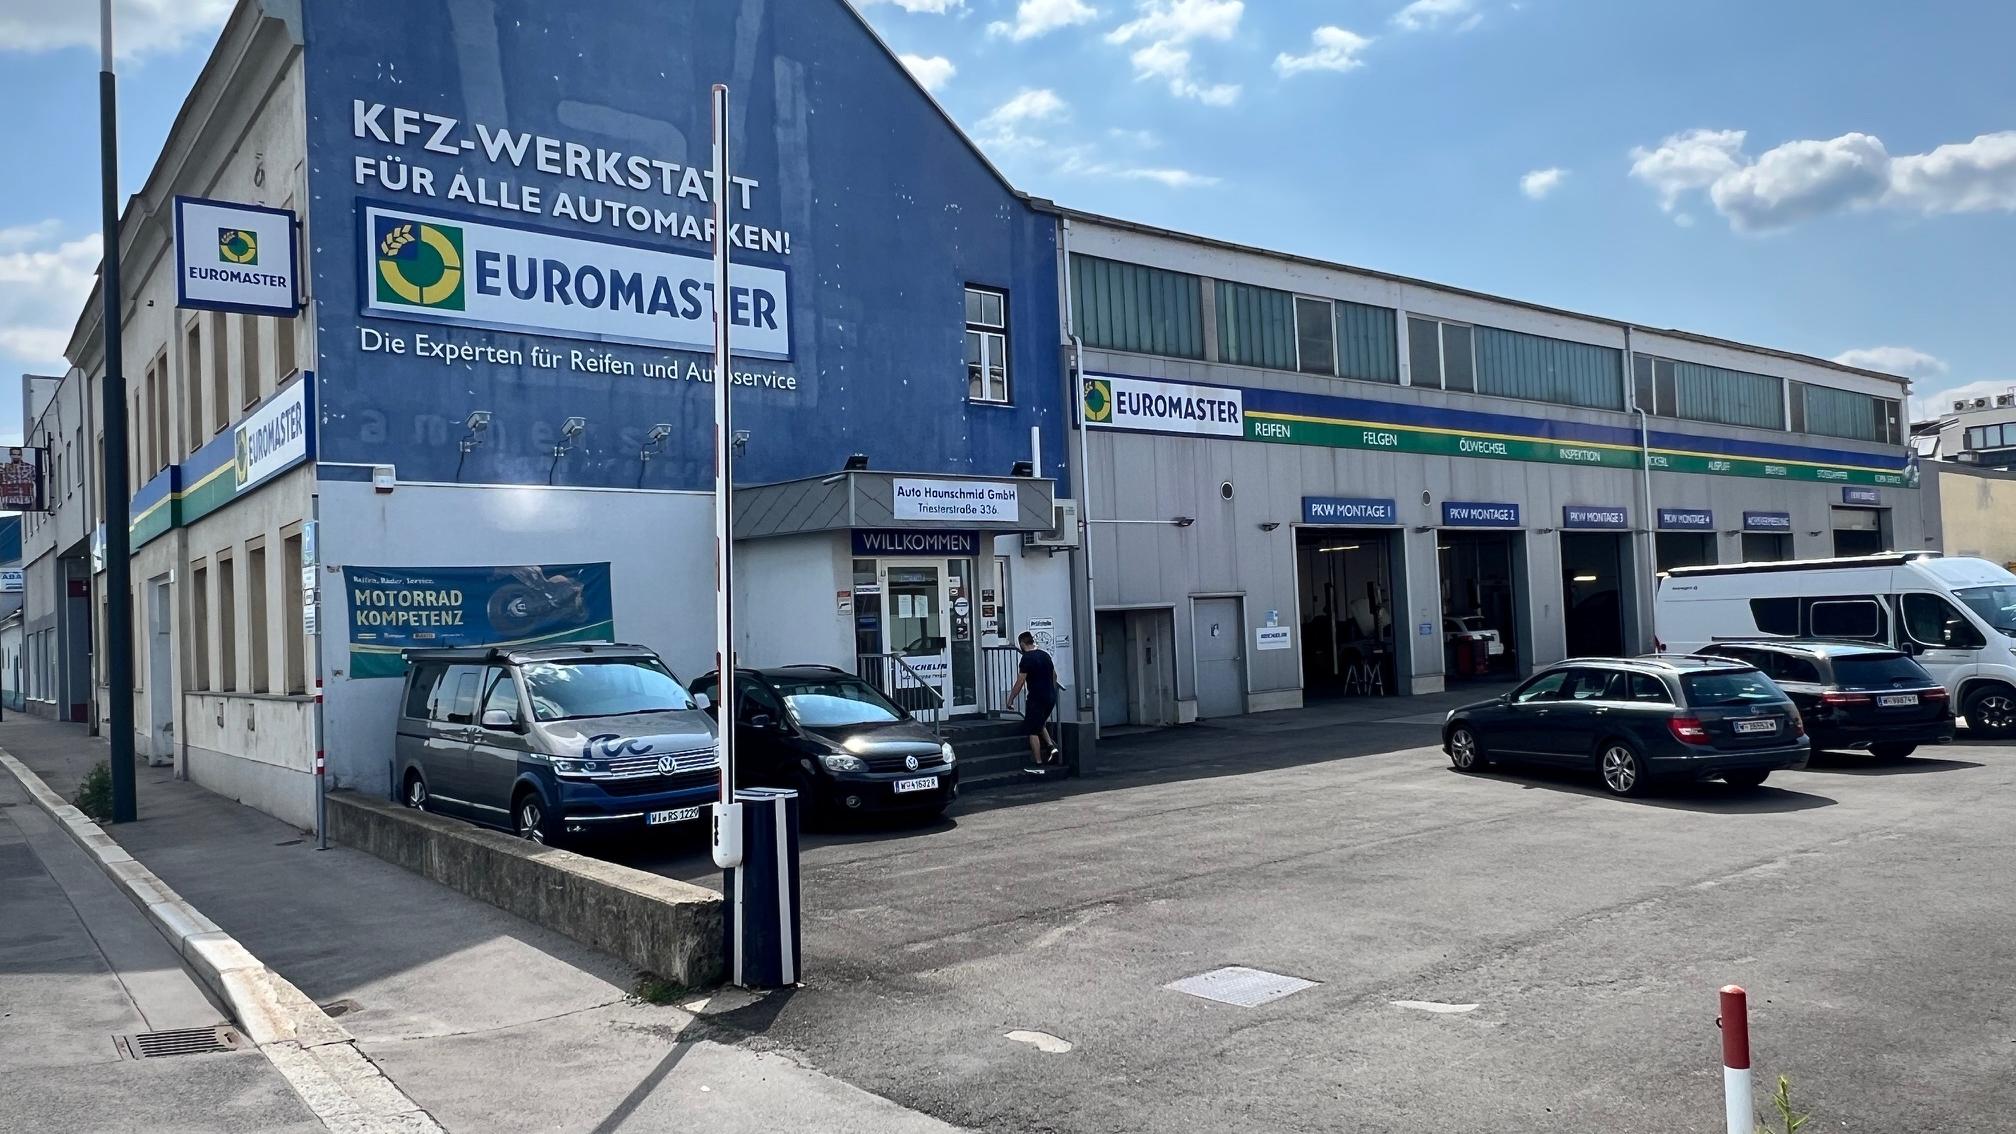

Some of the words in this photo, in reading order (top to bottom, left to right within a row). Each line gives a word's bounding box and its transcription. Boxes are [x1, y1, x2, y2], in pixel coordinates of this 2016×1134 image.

[355, 155, 436, 196] FÜR
[448, 173, 541, 214] ALLE
[189, 266, 287, 288] EUROMASTER
[360, 328, 406, 354] Die
[415, 333, 522, 366] Experten
[530, 346, 562, 369] für
[571, 349, 635, 376] Reifen
[643, 361, 678, 379] und
[1117, 391, 1239, 424] EUROMASTER
[249, 400, 302, 467] EUROMASTER
[1255, 422, 1290, 438] REIFEN
[1363, 431, 1398, 446] FELGEN
[1459, 438, 1508, 455] ÖLWECHSEL
[1559, 448, 1601, 462] INSPEKTION
[897, 486, 921, 497] Auto
[924, 487, 984, 499] Haunschmid
[987, 489, 1016, 500] GmbH
[918, 503, 977, 514] Triesterstraße
[1312, 504, 1335, 516] PKW
[1337, 505, 1385, 517] MONTAGE
[1449, 508, 1469, 518] PKW
[1471, 509, 1509, 520] MONTAGE
[1510, 510, 1515, 520] 2
[1570, 512, 1586, 521] PKW
[1587, 512, 1619, 523] MONTAGE
[863, 534, 971, 551] WILLKOMMEN
[355, 589, 463, 607] MOTORRAD
[357, 610, 464, 626] KOMPETENZ
